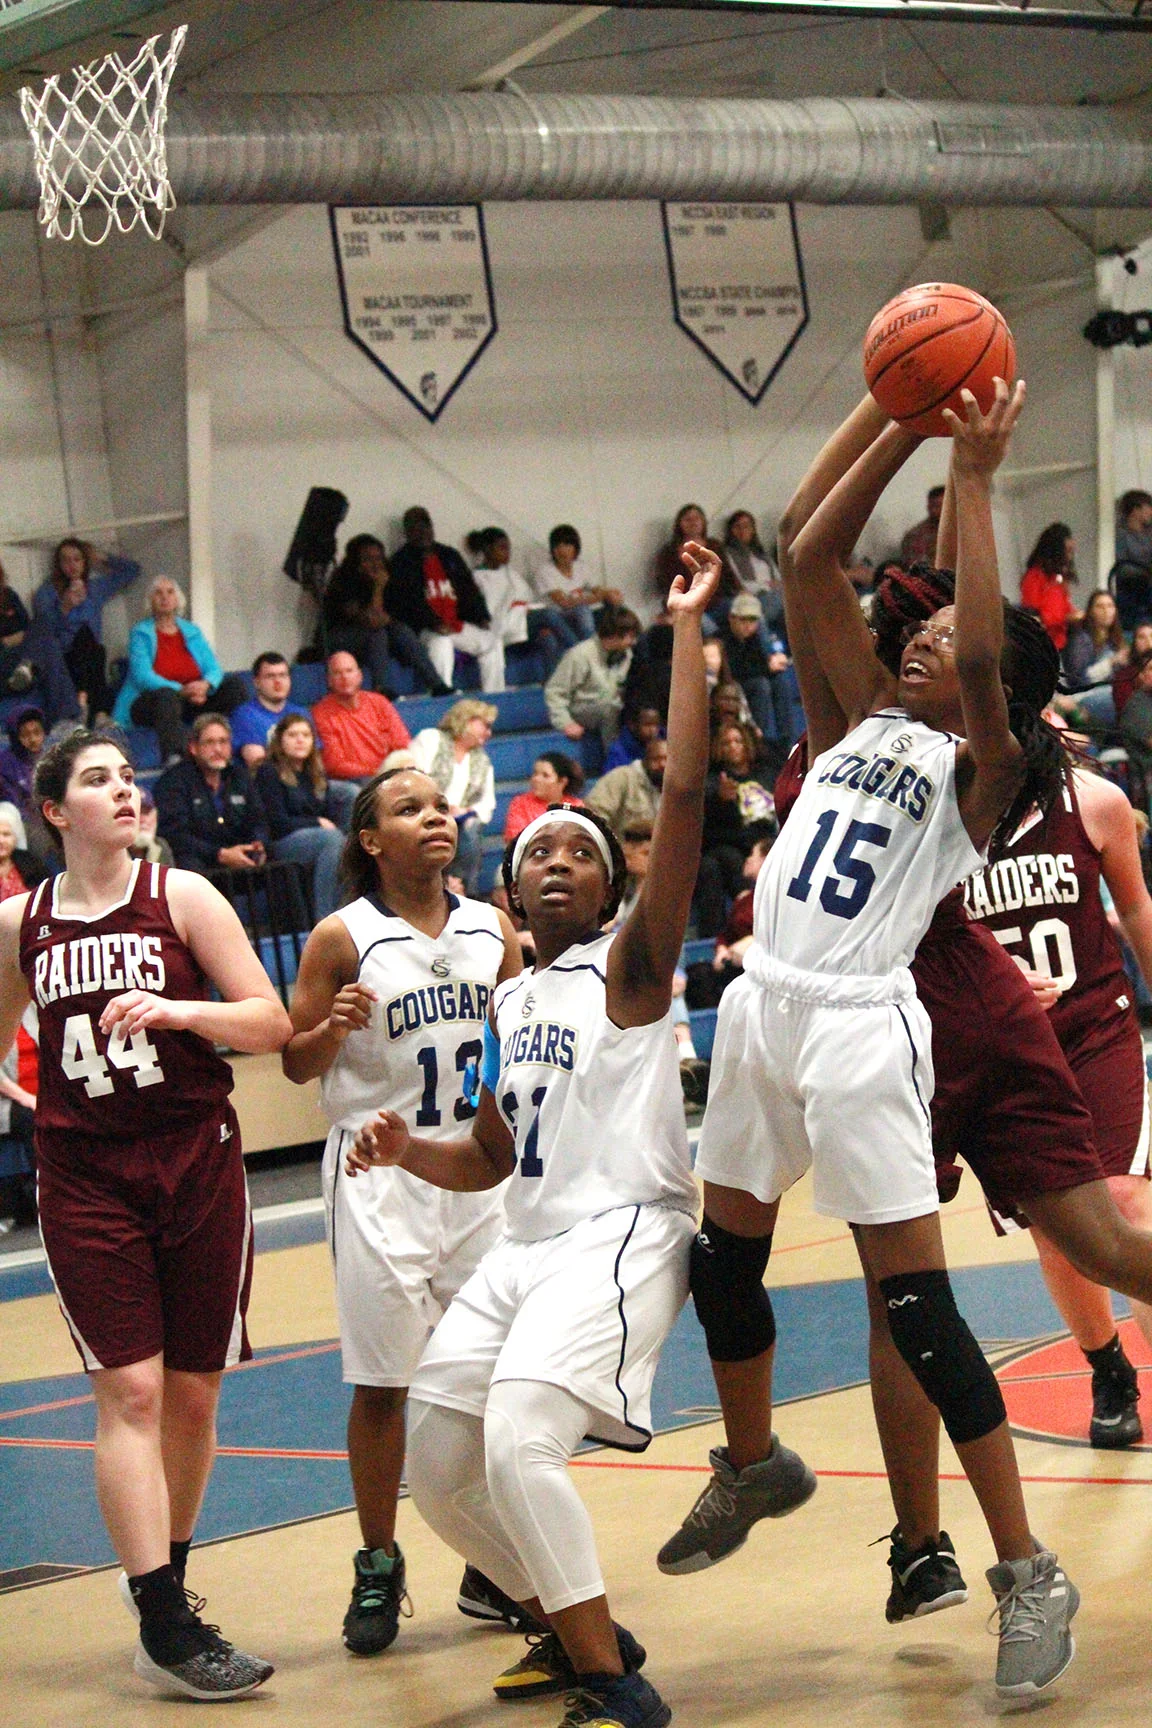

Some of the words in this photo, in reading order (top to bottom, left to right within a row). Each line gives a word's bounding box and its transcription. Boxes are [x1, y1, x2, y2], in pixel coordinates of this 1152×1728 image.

[392, 210, 463, 224] CONFERENCE
[786, 808, 892, 920] 15
[34, 932, 166, 1010] RAIDERS
[386, 981, 495, 1041] COUGAR
[61, 1013, 165, 1099] 44
